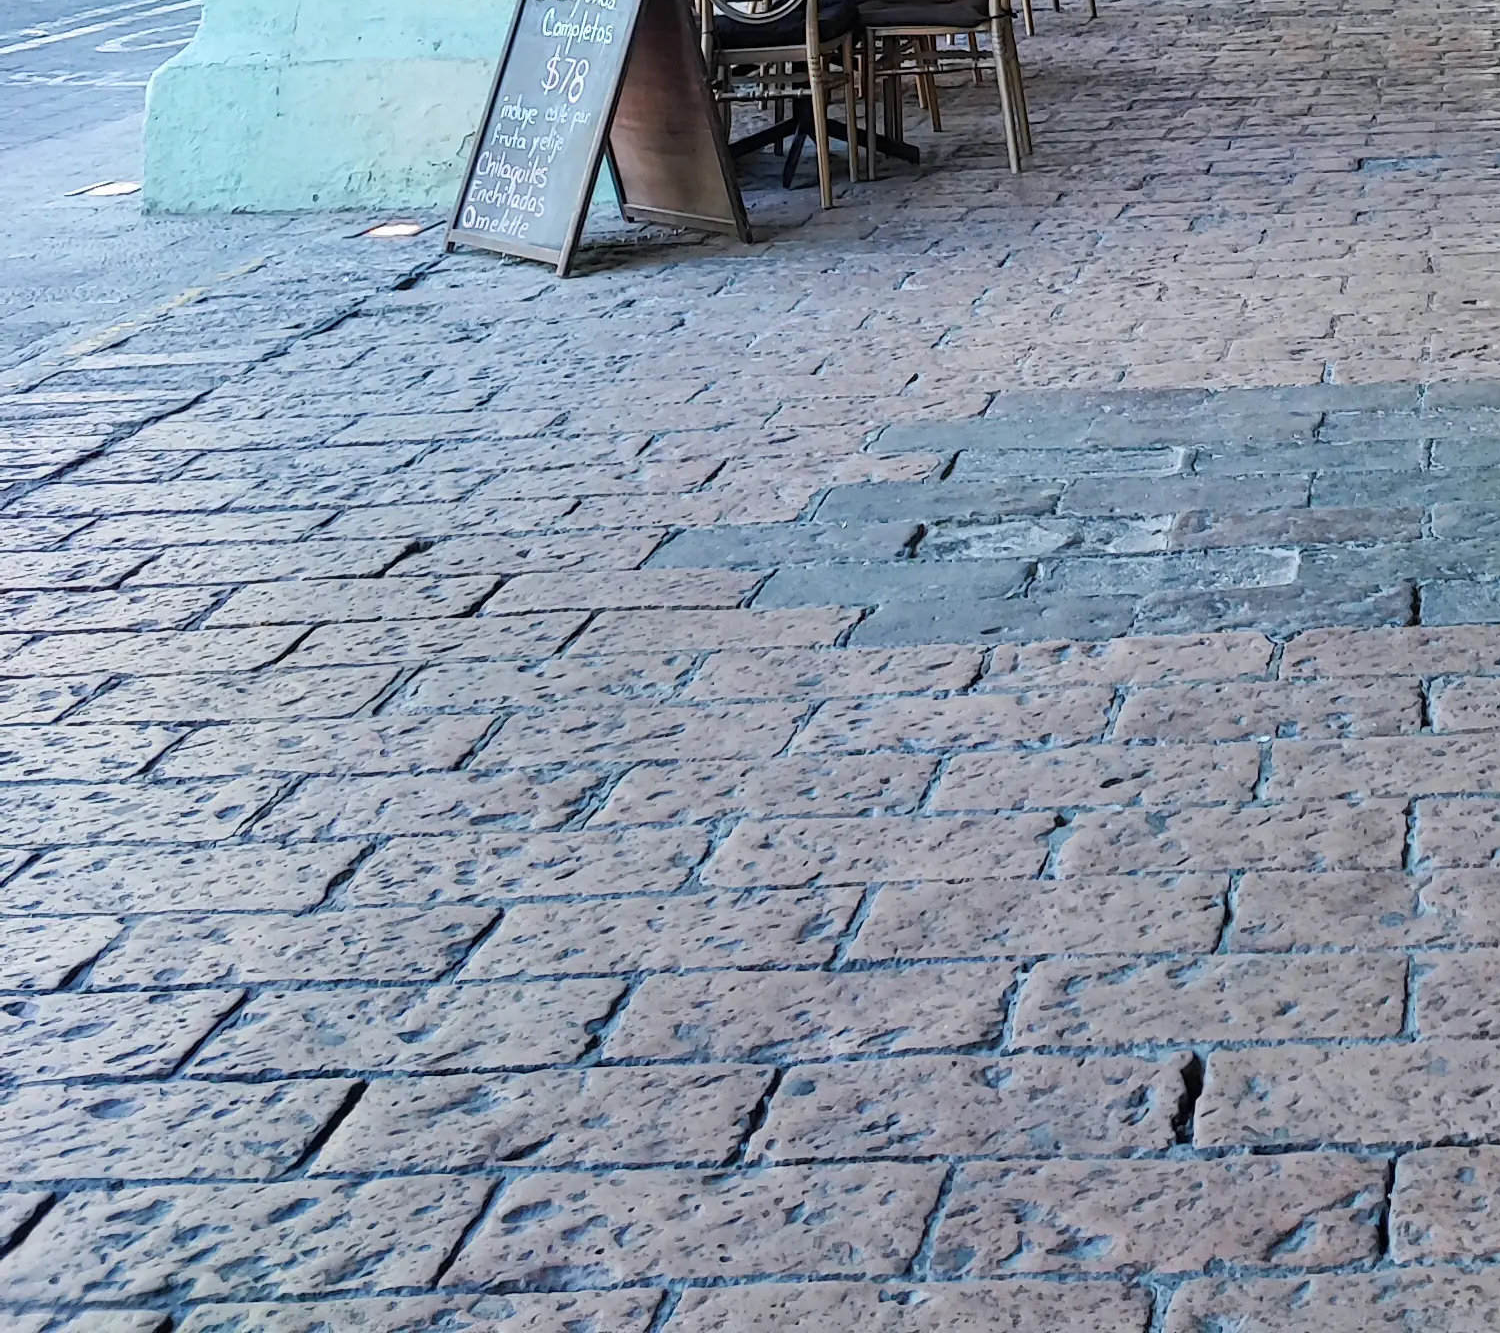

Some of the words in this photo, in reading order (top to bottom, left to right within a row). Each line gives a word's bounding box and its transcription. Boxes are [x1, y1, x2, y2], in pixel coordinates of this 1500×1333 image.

[542, 7, 613, 55] Completos
[540, 43, 589, 103] $78
[491, 122, 526, 150] fruta
[468, 179, 545, 218] Enchiladas
[462, 204, 529, 239] Omelette
